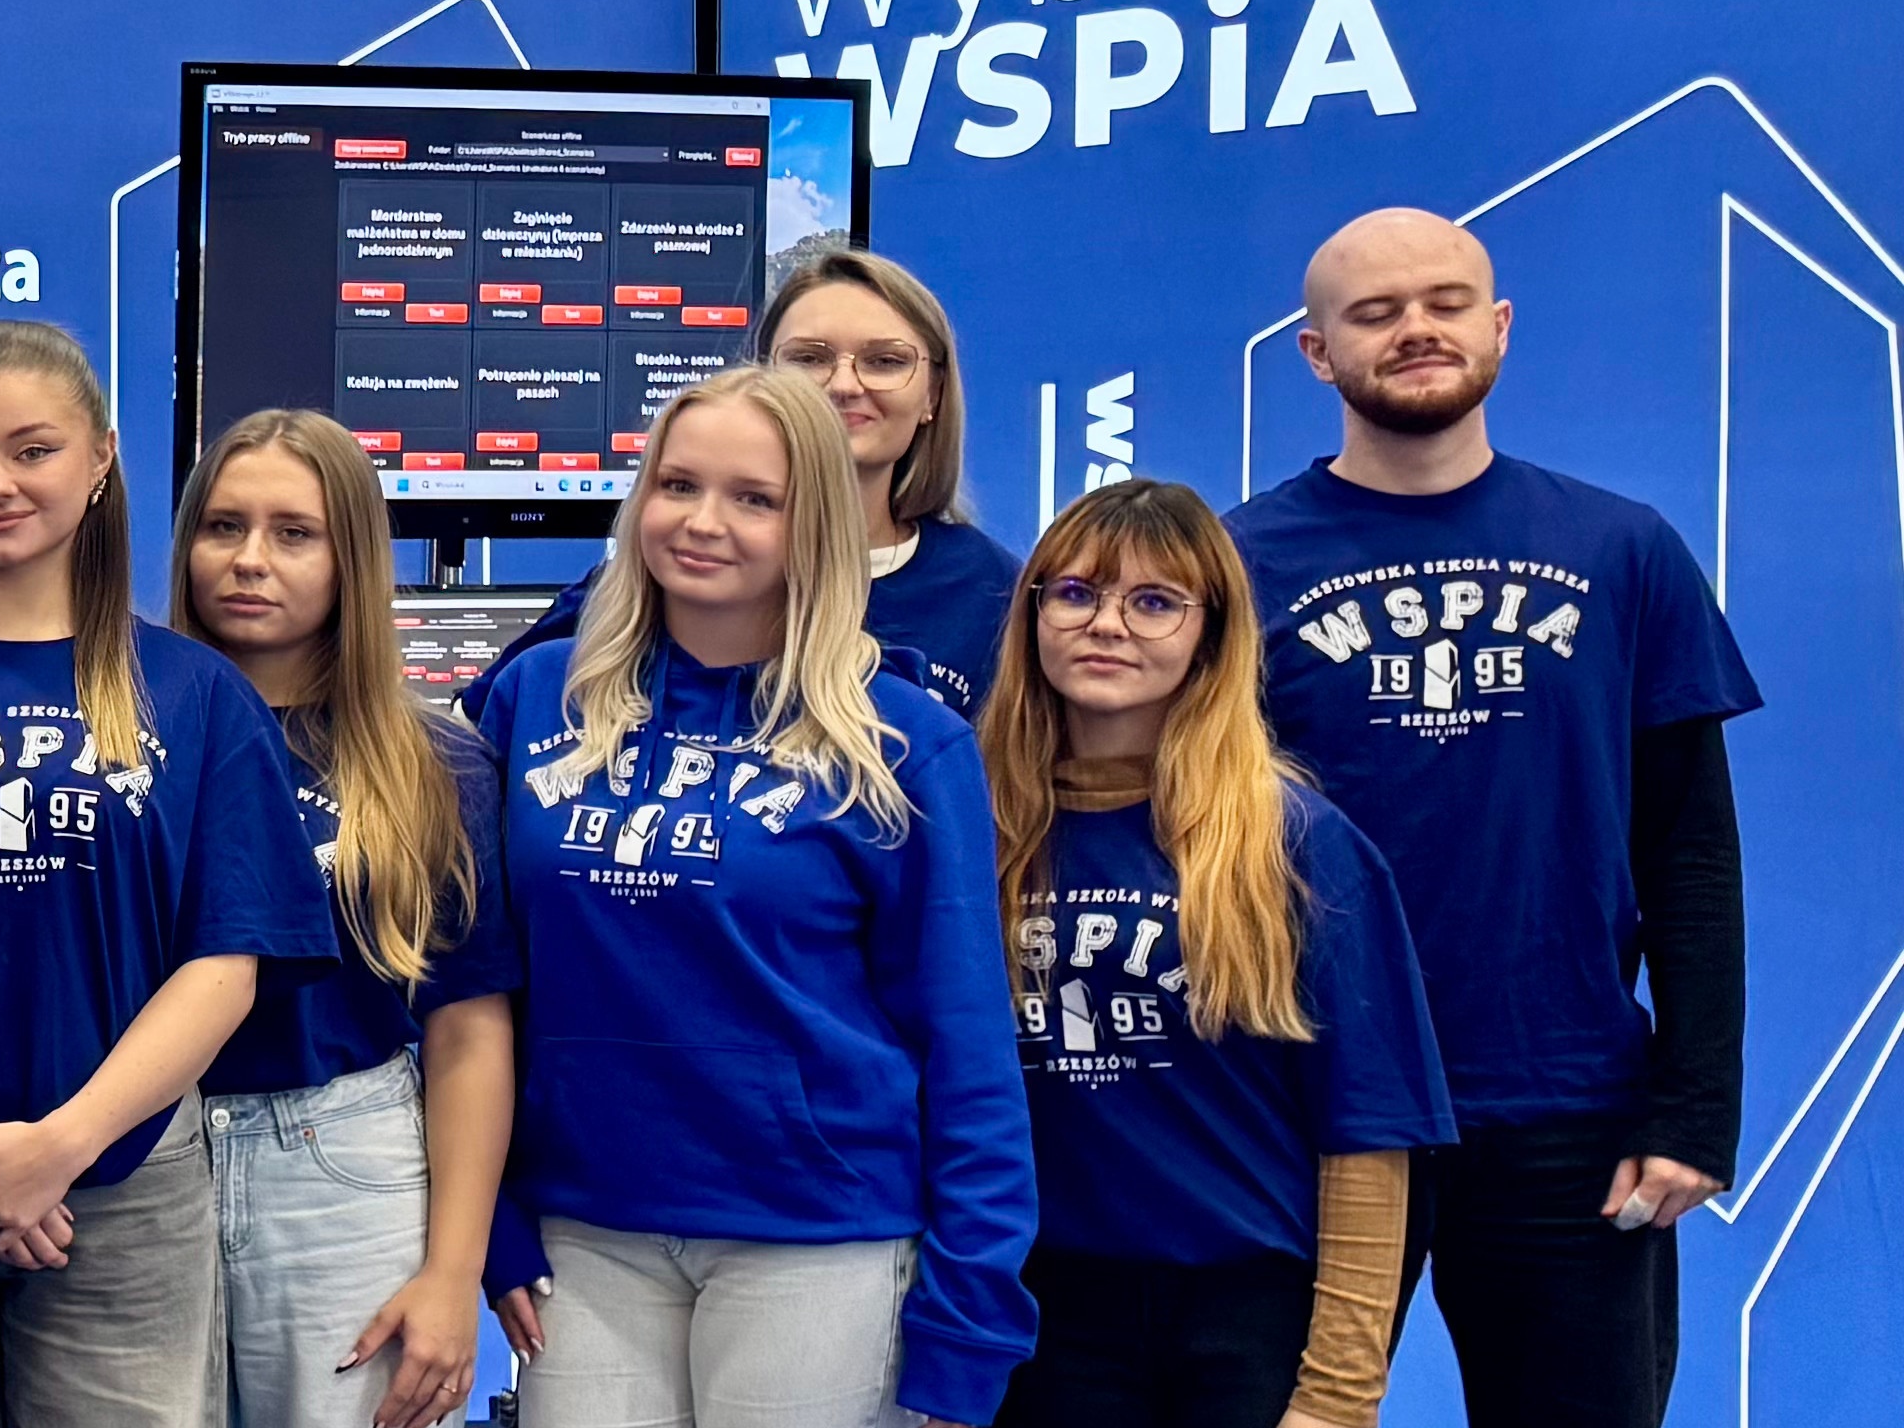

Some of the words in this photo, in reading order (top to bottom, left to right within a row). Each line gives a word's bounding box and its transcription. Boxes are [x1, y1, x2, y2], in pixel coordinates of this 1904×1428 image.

[1298, 580, 1582, 664] WSPIA
[1370, 658, 1411, 693] 19
[1474, 651, 1524, 687] 95
[525, 745, 806, 835] WSPIA
[49, 792, 98, 833] 95
[564, 810, 609, 844] 19
[589, 869, 679, 887] RZESZÓW
[1110, 997, 1164, 1034] 95
